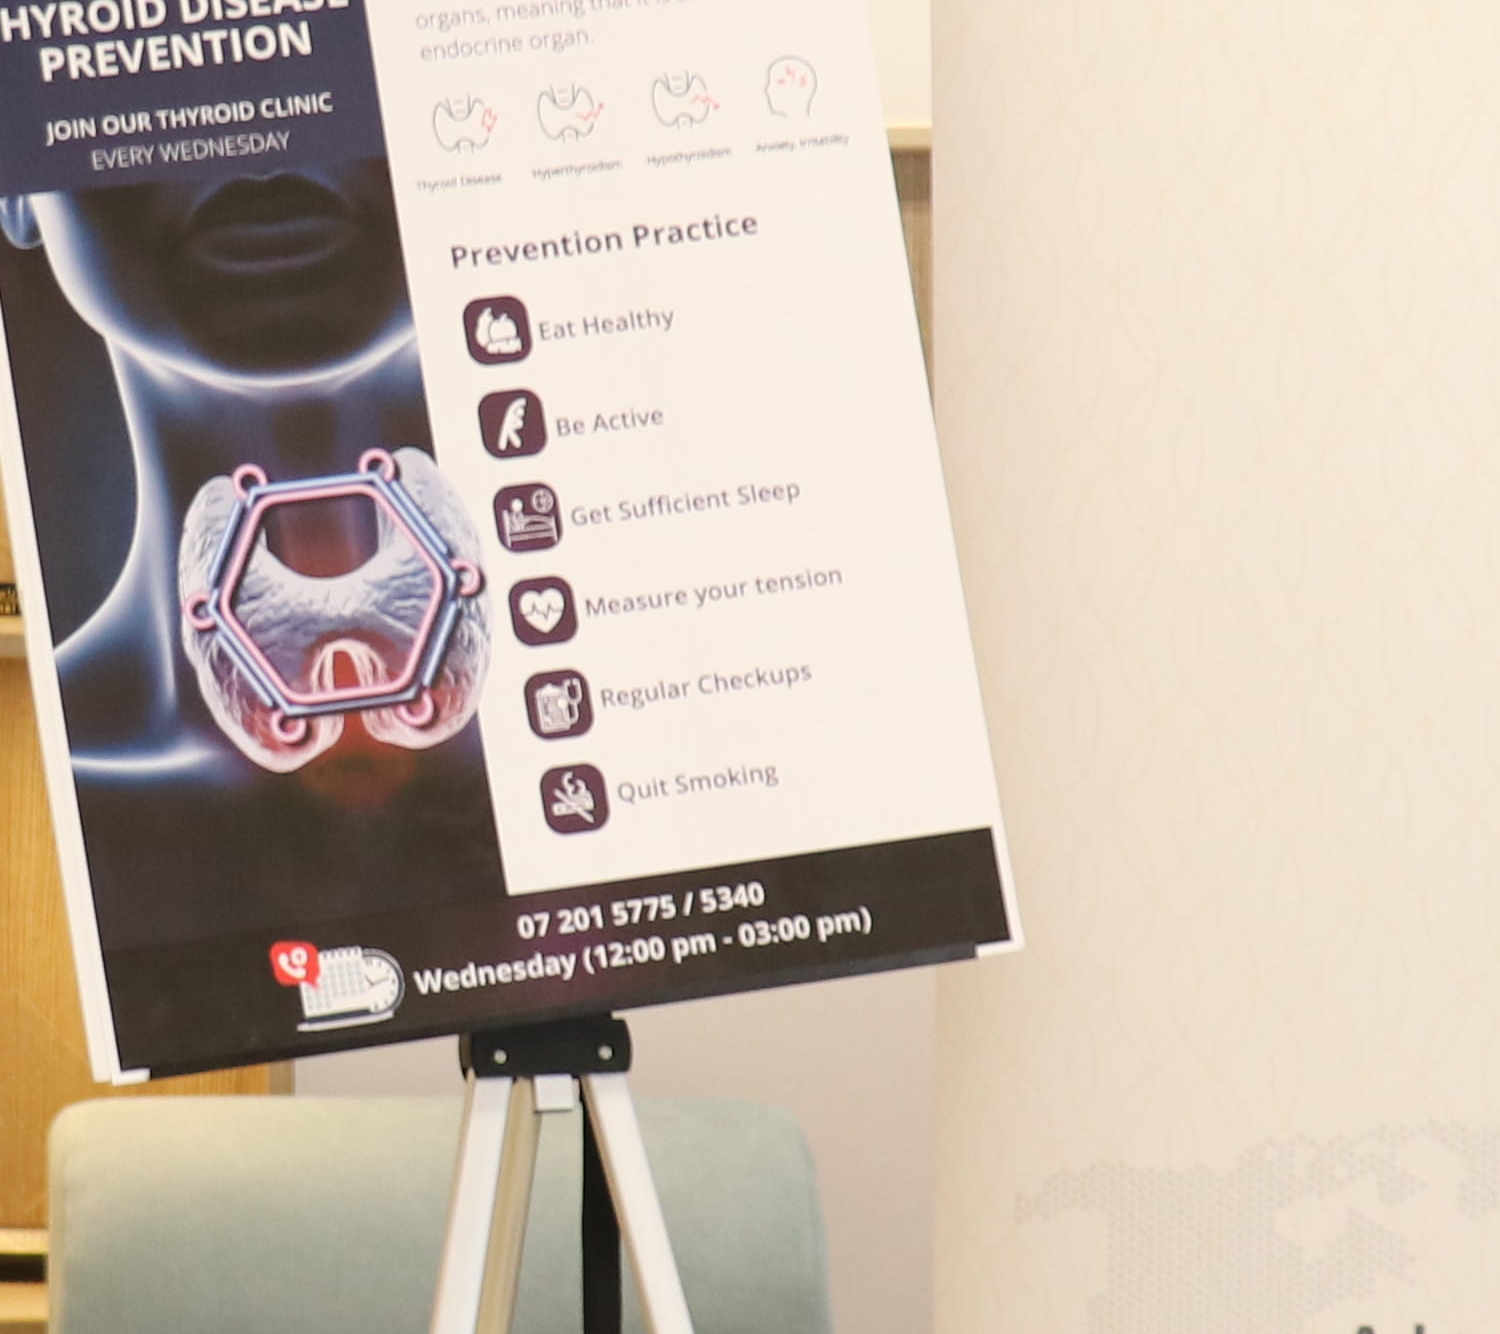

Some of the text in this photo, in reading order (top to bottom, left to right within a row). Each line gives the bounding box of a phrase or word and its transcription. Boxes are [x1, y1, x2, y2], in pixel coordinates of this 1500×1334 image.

[415, 7, 490, 33] organs,
[39, 20, 311, 82] PREVENTION
[419, 28, 594, 62] endocrine organ.
[46, 91, 333, 146] JOIN OUR THYROID CLINIC
[90, 130, 289, 170] EVERY WEDNESDAY
[450, 214, 757, 269] Prevention Practice
[537, 308, 673, 341] Eat Healthy
[554, 407, 663, 437] Be Active
[570, 482, 800, 526] Get Sufficient Sleep
[584, 569, 842, 617] Measure your tension
[599, 665, 812, 709] Regular Checkups
[616, 765, 779, 805] Quit Smoking
[516, 881, 764, 939] 07 201 5775 / 5340
[412, 906, 871, 994] Wednesday (12:00 pm - 03:00 pm)
